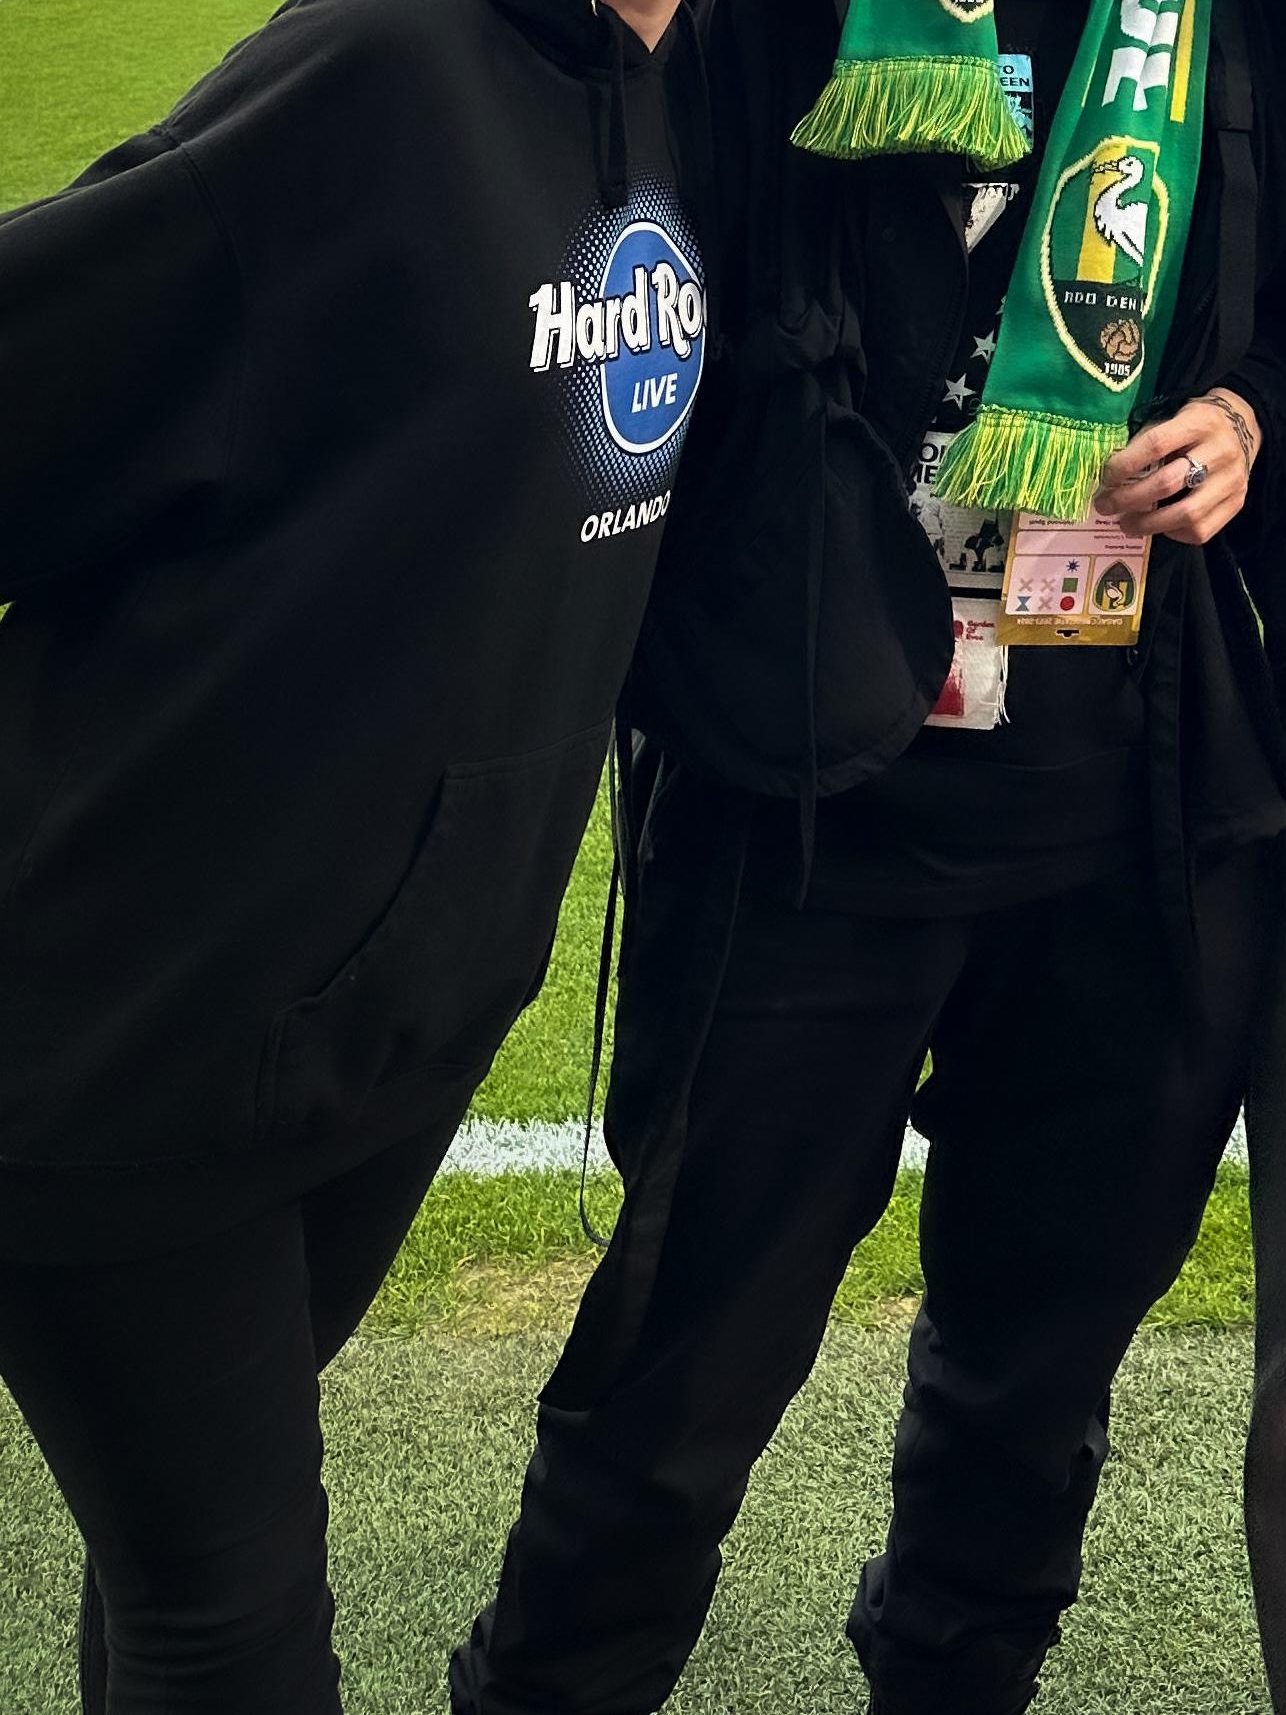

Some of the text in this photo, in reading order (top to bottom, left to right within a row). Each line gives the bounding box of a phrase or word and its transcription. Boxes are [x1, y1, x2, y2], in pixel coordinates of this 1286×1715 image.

[529, 261, 707, 373] Hard Ro
[631, 372, 679, 414] LIVE
[580, 489, 671, 543] ORLANDO
